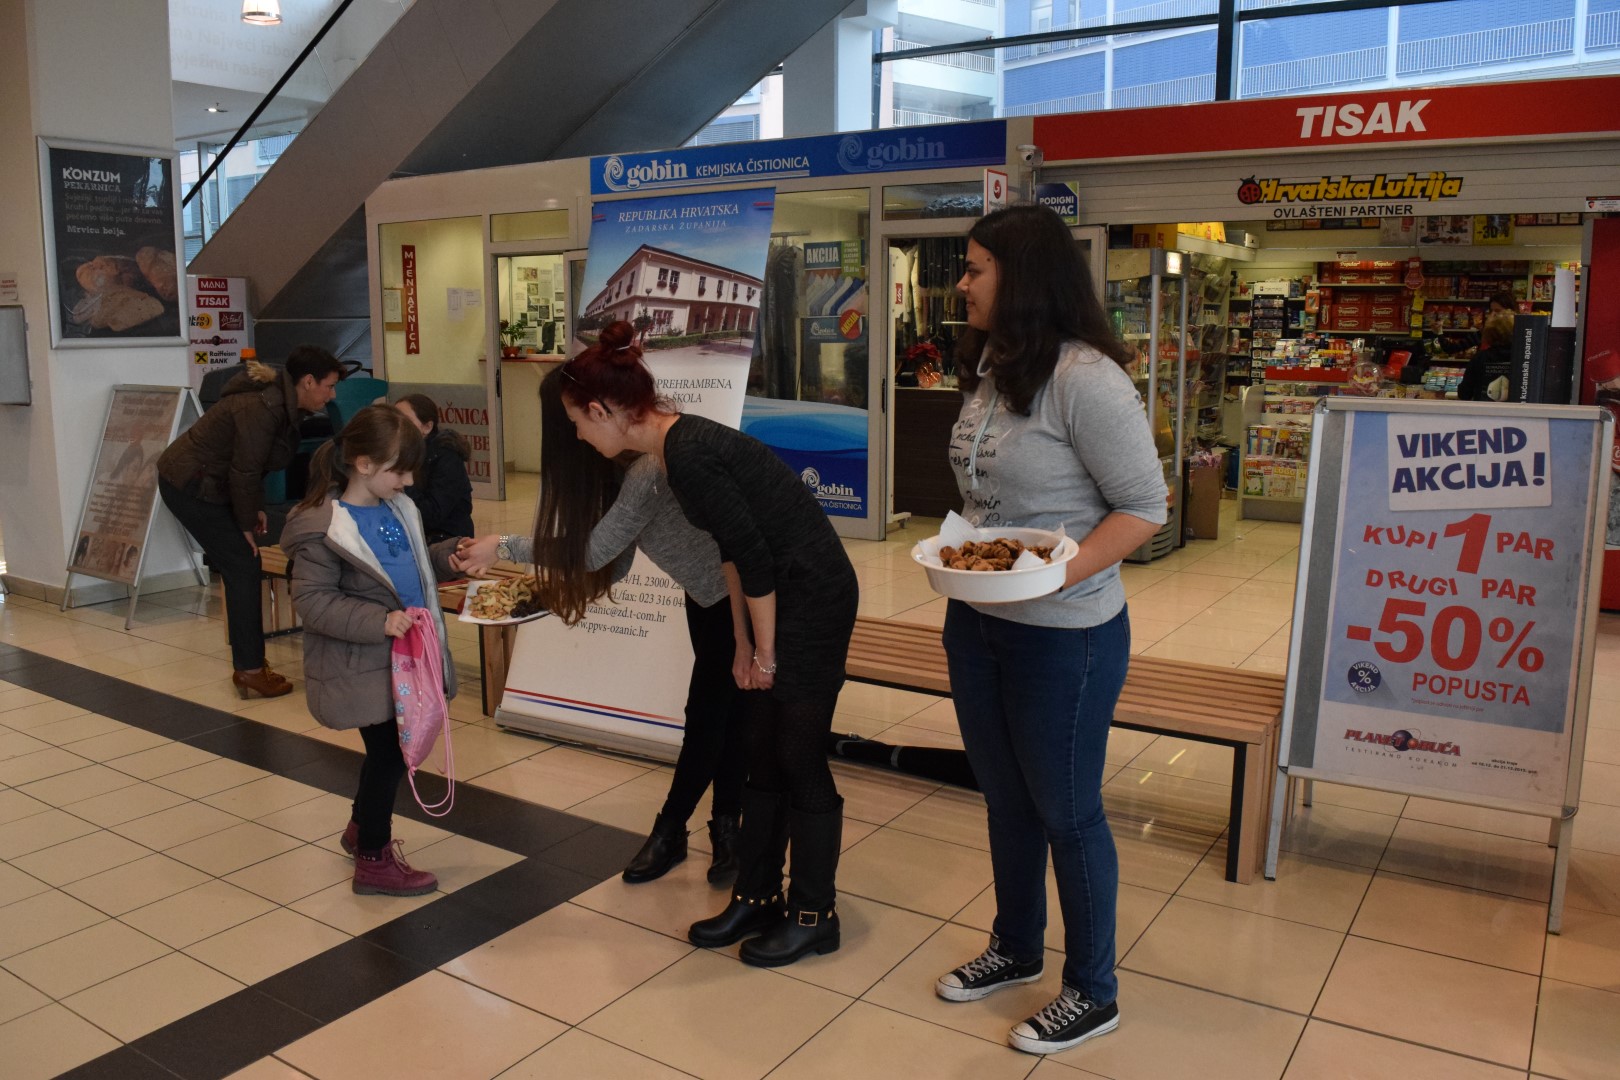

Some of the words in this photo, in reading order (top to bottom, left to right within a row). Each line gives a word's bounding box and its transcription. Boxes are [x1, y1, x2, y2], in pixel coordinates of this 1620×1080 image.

[1296, 99, 1431, 138] TISAK
[867, 137, 946, 170] gobin
[63, 167, 120, 183] KONZUM
[627, 160, 688, 188] gobin
[696, 163, 744, 177] KEMIJSKA
[747, 156, 810, 172] ČISTIONICA
[63, 181, 121, 192] PEKARNICA
[1258, 175, 1370, 203] Hrvatska
[1369, 171, 1464, 202] Lutrija
[1039, 196, 1074, 205] PODIGNI
[618, 208, 677, 223] REPUBLIKA
[681, 203, 739, 218] HRVATSKA
[1049, 205, 1074, 214] VAC
[1273, 205, 1347, 218] OVLAŠTENI
[1350, 204, 1413, 216] PARTNER
[625, 223, 674, 233] ZADARSKA
[679, 220, 727, 230] ŽUPANIJA
[806, 247, 839, 263] AKCIJA
[200, 281, 226, 289] MANA
[199, 298, 229, 306] TISAK
[404, 251, 417, 350] MJENJAČNICA
[1524, 328, 1533, 360] aparata!
[656, 378, 732, 389] PREHRAMBENA
[1520, 361, 1530, 399] kućanskih
[672, 391, 702, 403] ŠKOLA
[438, 401, 489, 425] AČNICA
[1397, 427, 1527, 459] VIKEND
[1392, 452, 1545, 493] AKCIJA!
[817, 483, 854, 497] gobin
[828, 500, 862, 511] ČISTIONICA
[1363, 525, 1438, 550] KUPI
[1443, 513, 1492, 575] 1
[1497, 531, 1555, 561] PAR
[644, 576, 670, 588] 23000
[1365, 568, 1458, 596] DRUGI
[1481, 579, 1537, 606] PAR
[639, 594, 654, 604] 023
[656, 595, 672, 605] 316
[1346, 597, 1544, 673] -50%
[1353, 662, 1379, 674] VIKEND
[1358, 670, 1371, 684] %
[1350, 681, 1376, 693] AKCIJA
[1412, 672, 1530, 706] POPUSTA
[1344, 729, 1403, 747] PLANET
[1345, 746, 1402, 759] TESTIRANO
